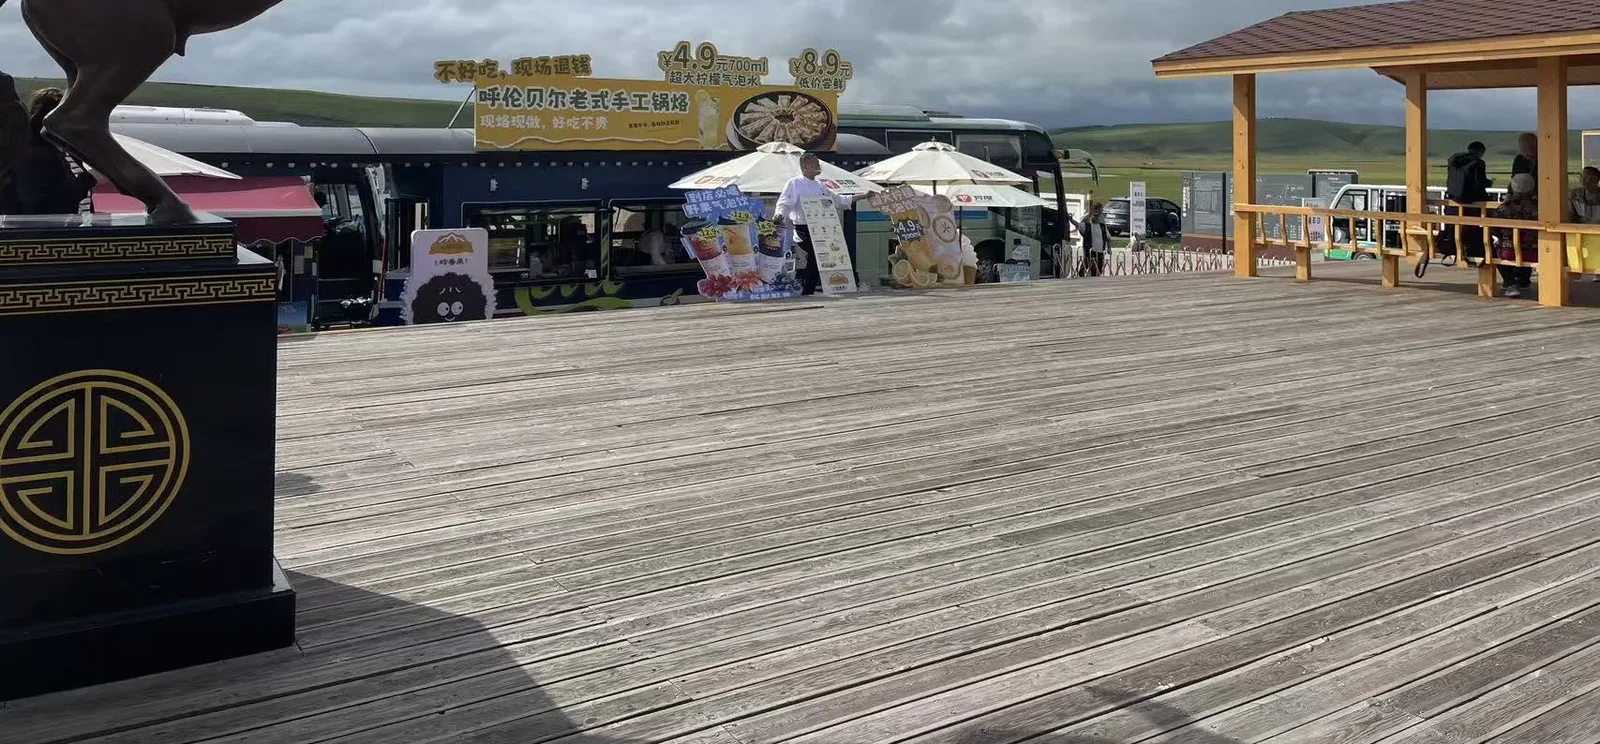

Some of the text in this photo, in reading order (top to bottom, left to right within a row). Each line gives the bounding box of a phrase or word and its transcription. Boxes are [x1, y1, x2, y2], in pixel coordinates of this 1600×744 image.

[669, 71, 759, 86] 超大柠檬气泡水
[799, 77, 845, 91] 低价尝鲜
[479, 86, 690, 113] 呼伦贝尔老式手工锅烙
